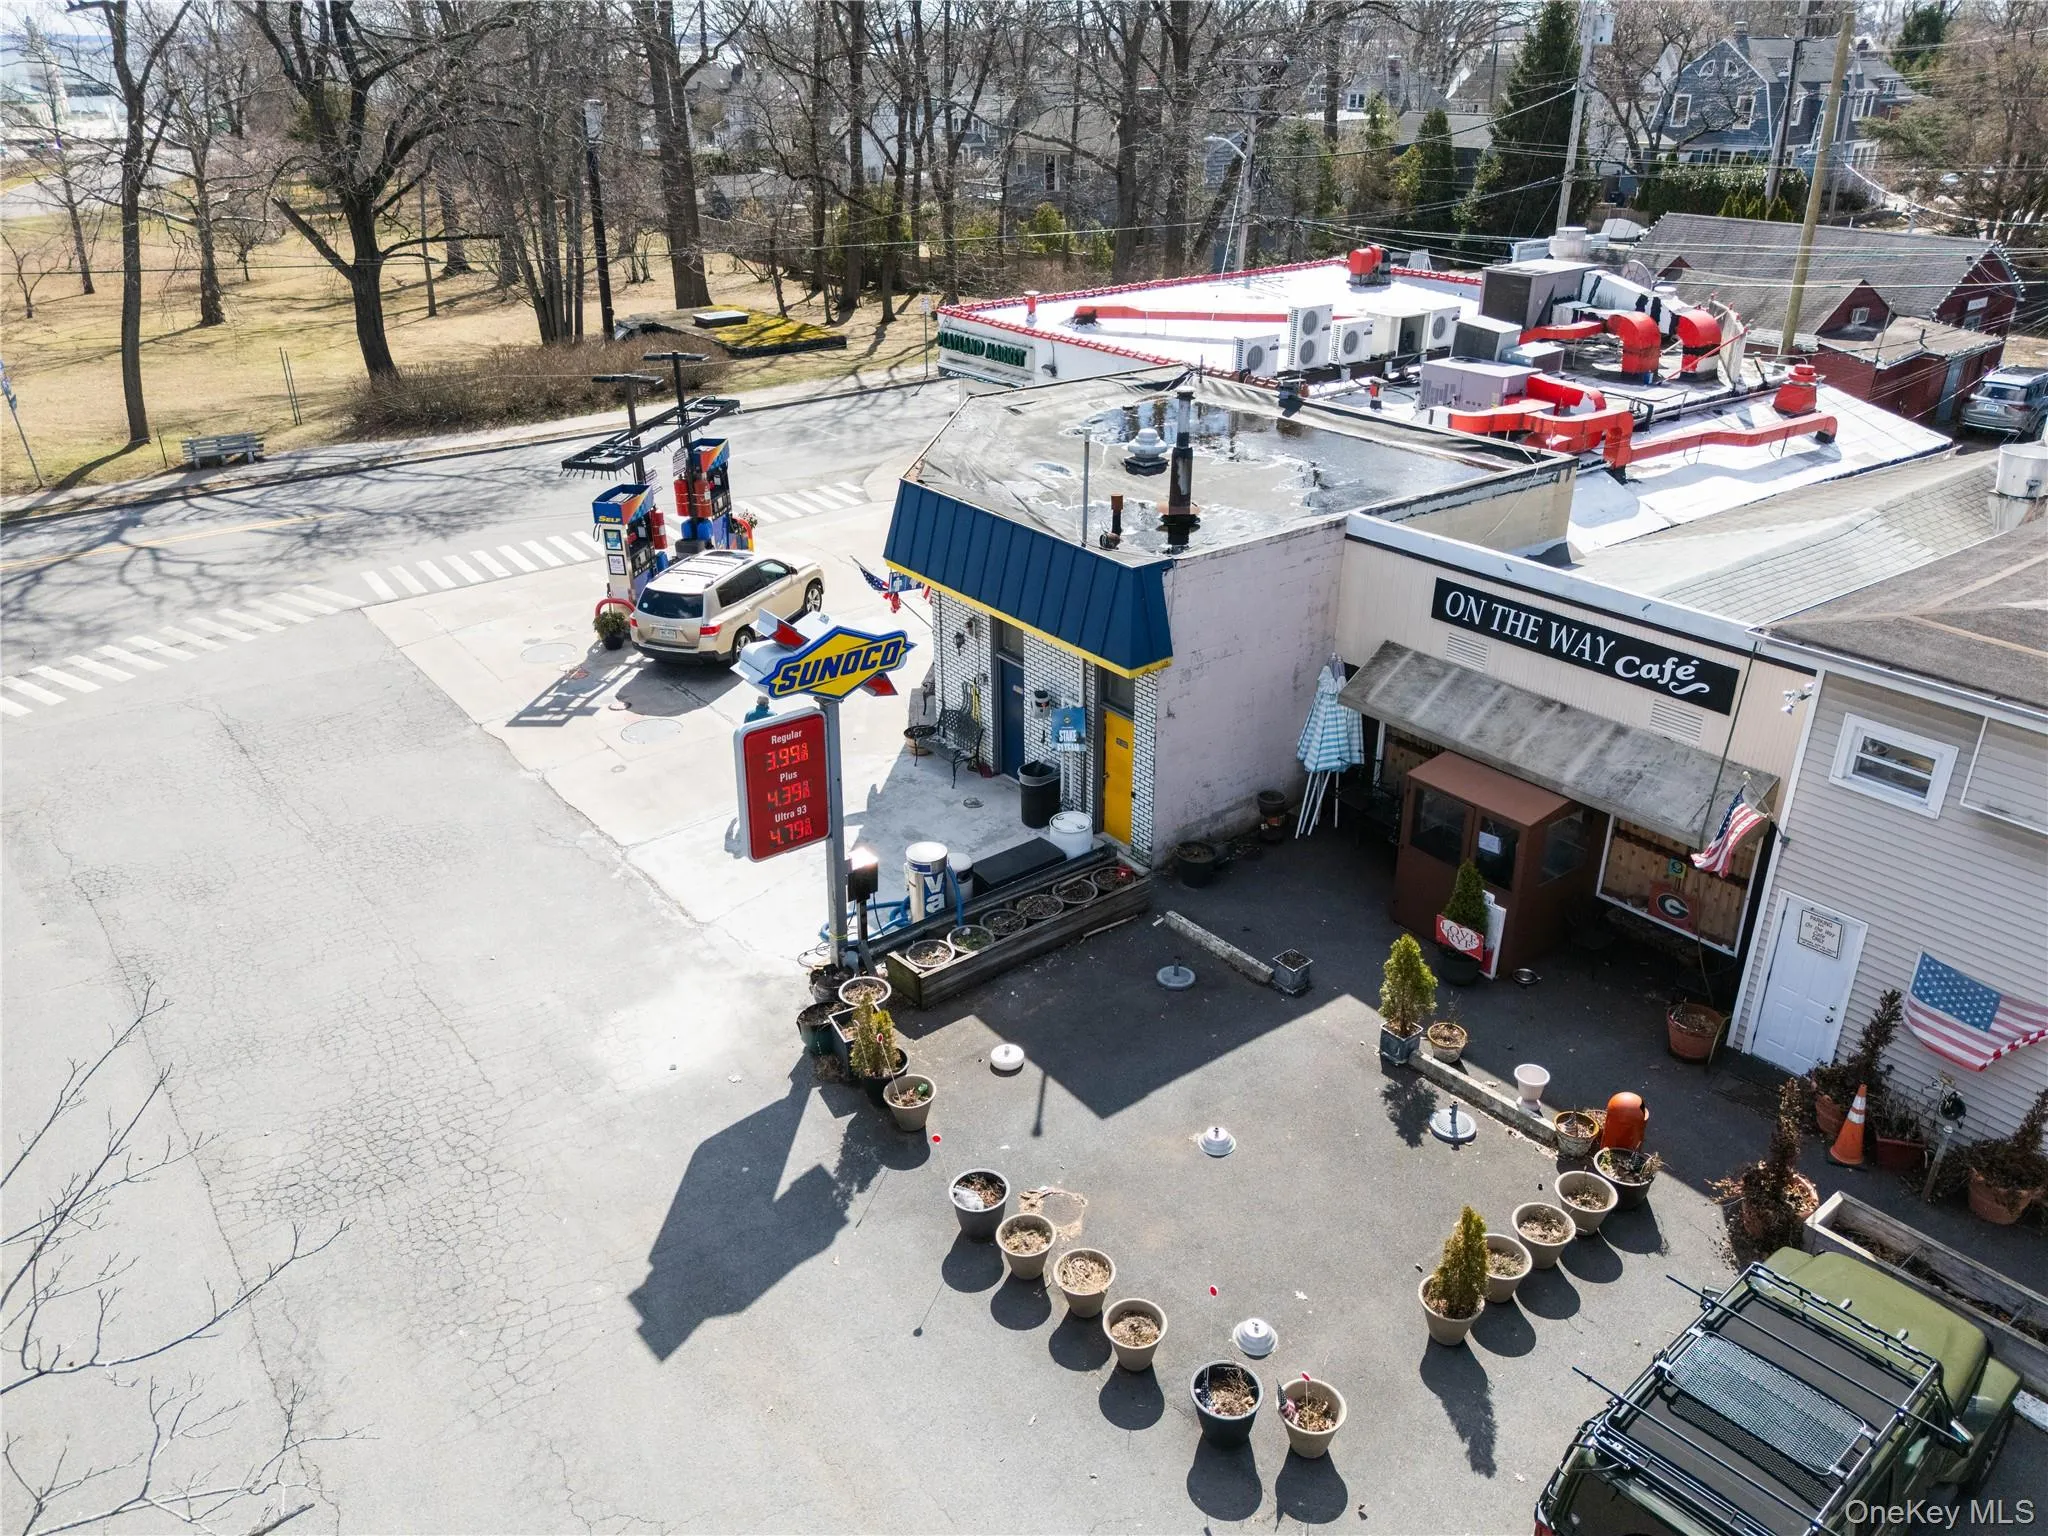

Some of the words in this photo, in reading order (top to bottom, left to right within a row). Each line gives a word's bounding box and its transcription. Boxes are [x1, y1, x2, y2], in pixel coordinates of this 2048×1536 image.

[985, 342, 1027, 367] MARKET
[1445, 591, 1486, 625] ON
[1489, 603, 1543, 644] THE
[1549, 621, 1616, 666] WAY
[1614, 655, 1702, 690] Café
[777, 639, 901, 692] SUNOCO
[771, 730, 802, 744] Regular
[780, 771, 798, 782] Plus
[774, 811, 795, 823] Ultra
[796, 804, 807, 816] 93
